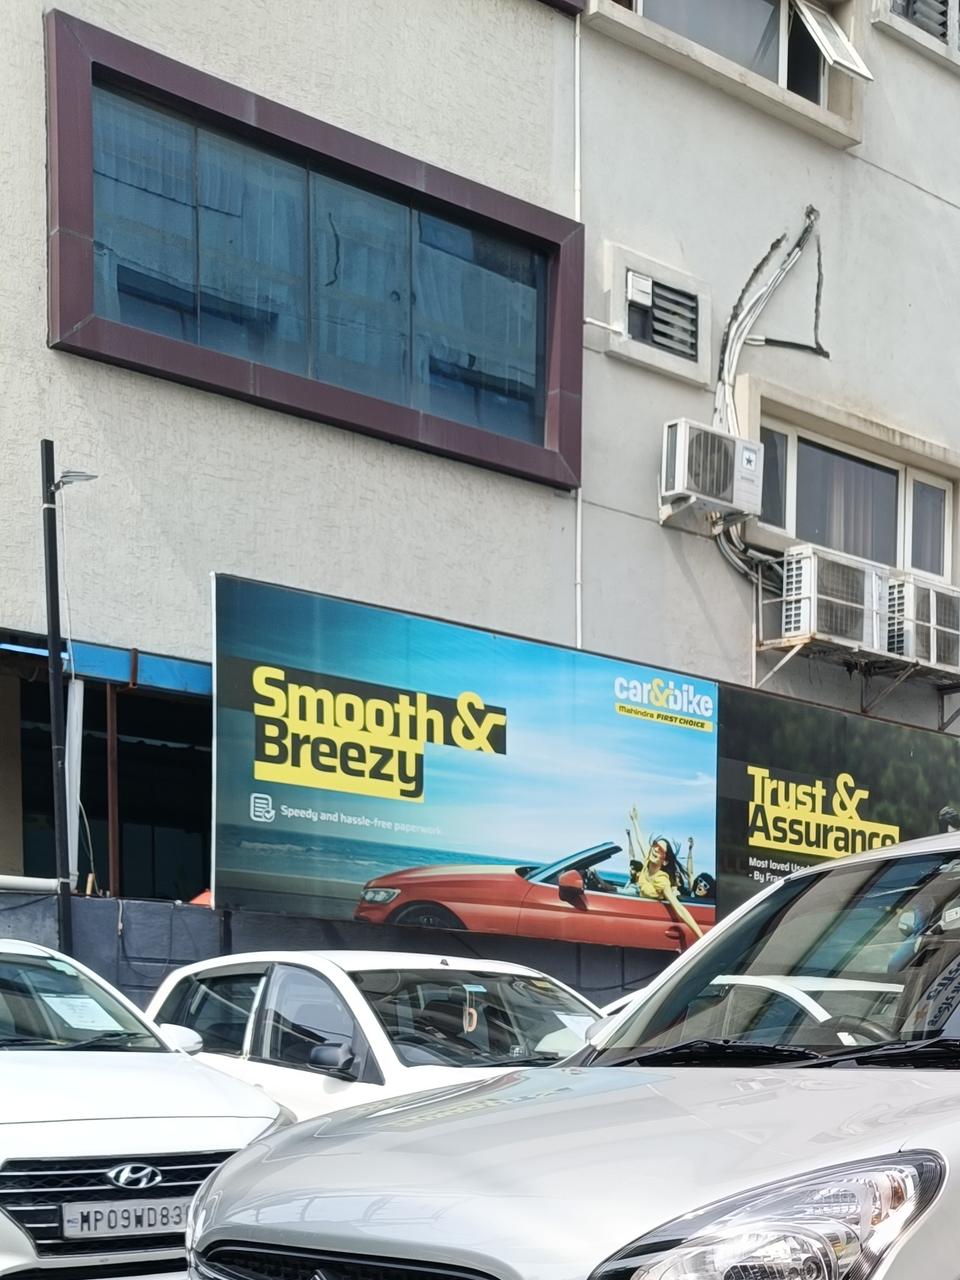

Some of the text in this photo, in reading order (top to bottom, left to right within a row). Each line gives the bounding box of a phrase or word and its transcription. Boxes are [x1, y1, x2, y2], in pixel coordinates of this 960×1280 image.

[252, 665, 507, 754] Smooth &
[614, 676, 713, 717] car&bike
[656, 713, 678, 723] FIRST
[678, 717, 705, 728] CHOICE
[255, 716, 424, 798] Breezy
[747, 765, 870, 821] Trust &
[280, 804, 441, 835] Speedy and hassle-free paperwork
[748, 856, 768, 868] Most
[769, 859, 790, 872] loved
[753, 870, 765, 883] By
